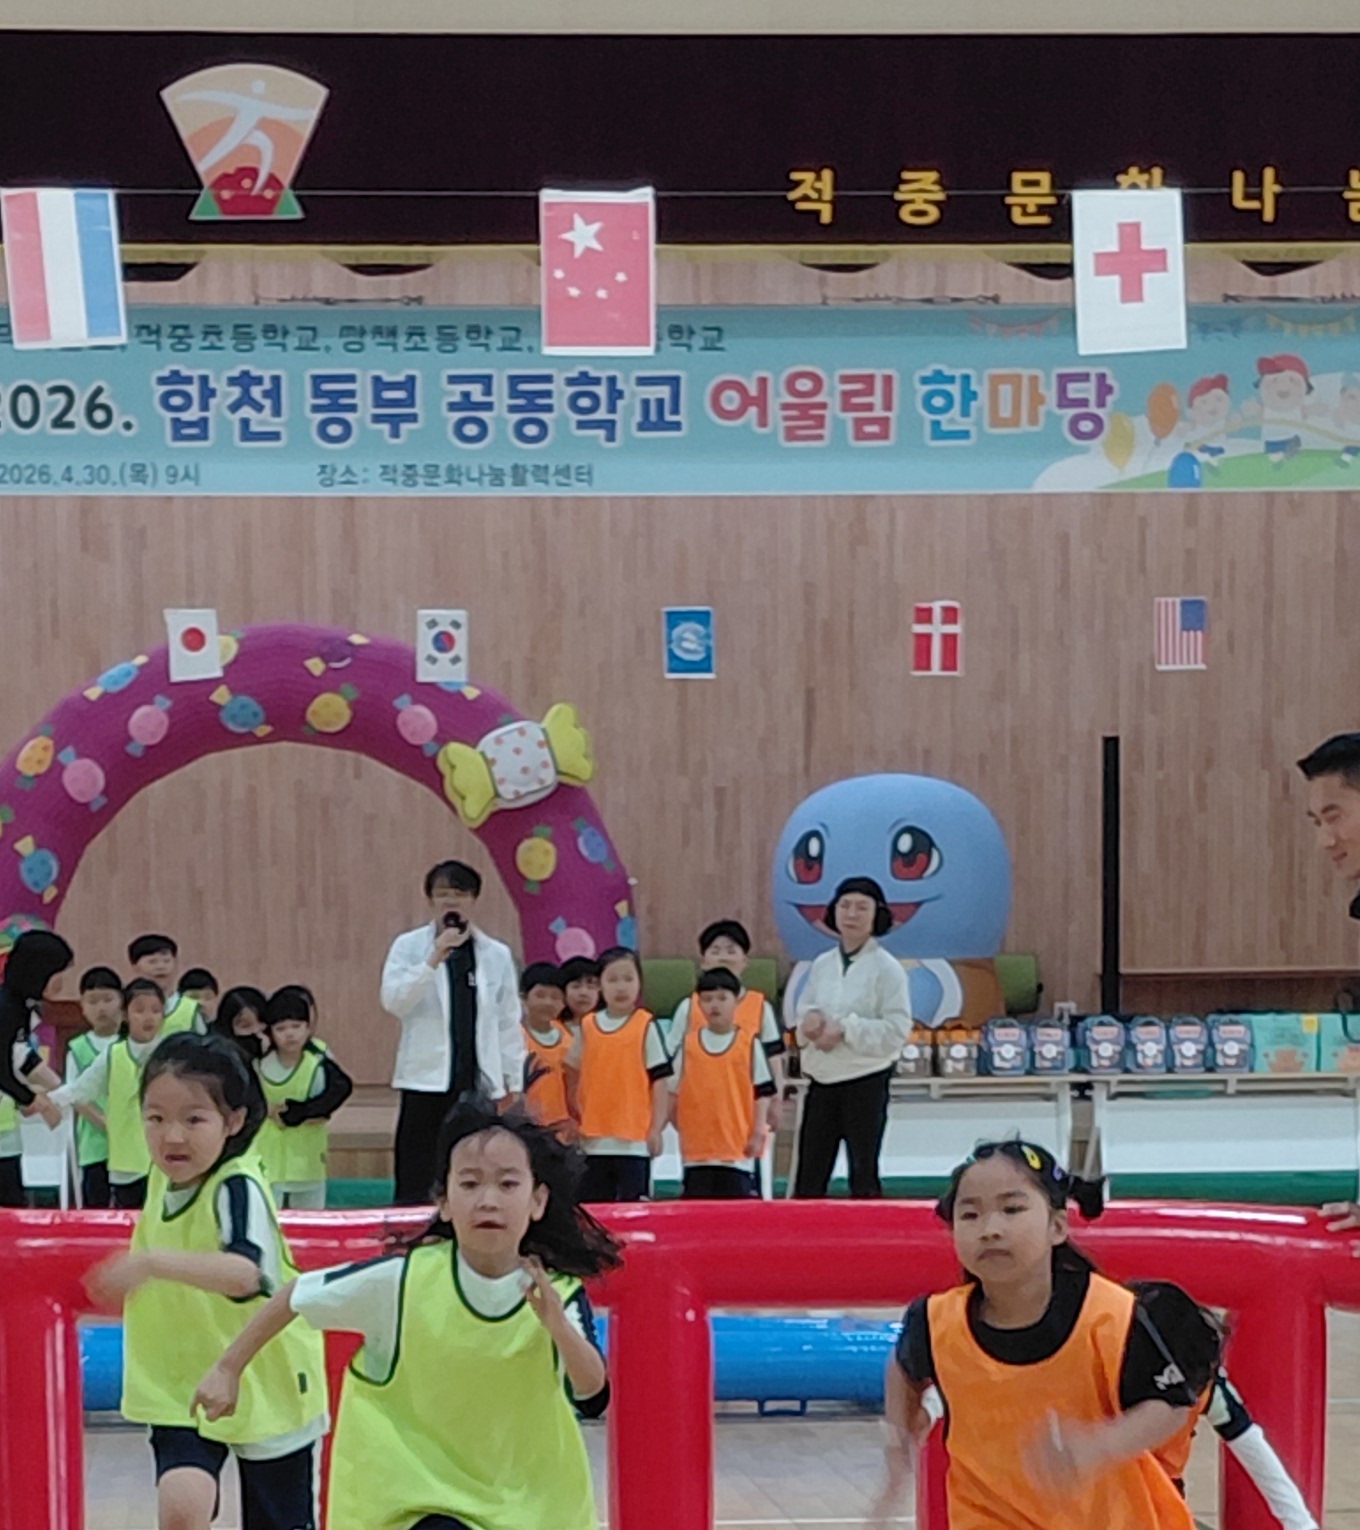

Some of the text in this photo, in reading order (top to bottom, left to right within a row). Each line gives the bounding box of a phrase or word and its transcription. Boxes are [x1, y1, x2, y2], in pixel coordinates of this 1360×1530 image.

[133, 322, 332, 354] 적중초등학교,
[154, 369, 283, 443] 합천
[309, 373, 419, 444] 동부
[446, 371, 683, 444] 공동학교
[709, 369, 894, 443] 어울림
[919, 370, 1114, 441] 한마당
[165, 462, 201, 487] 9시
[316, 463, 594, 487] 장소: 적중문화나눔활력센터
